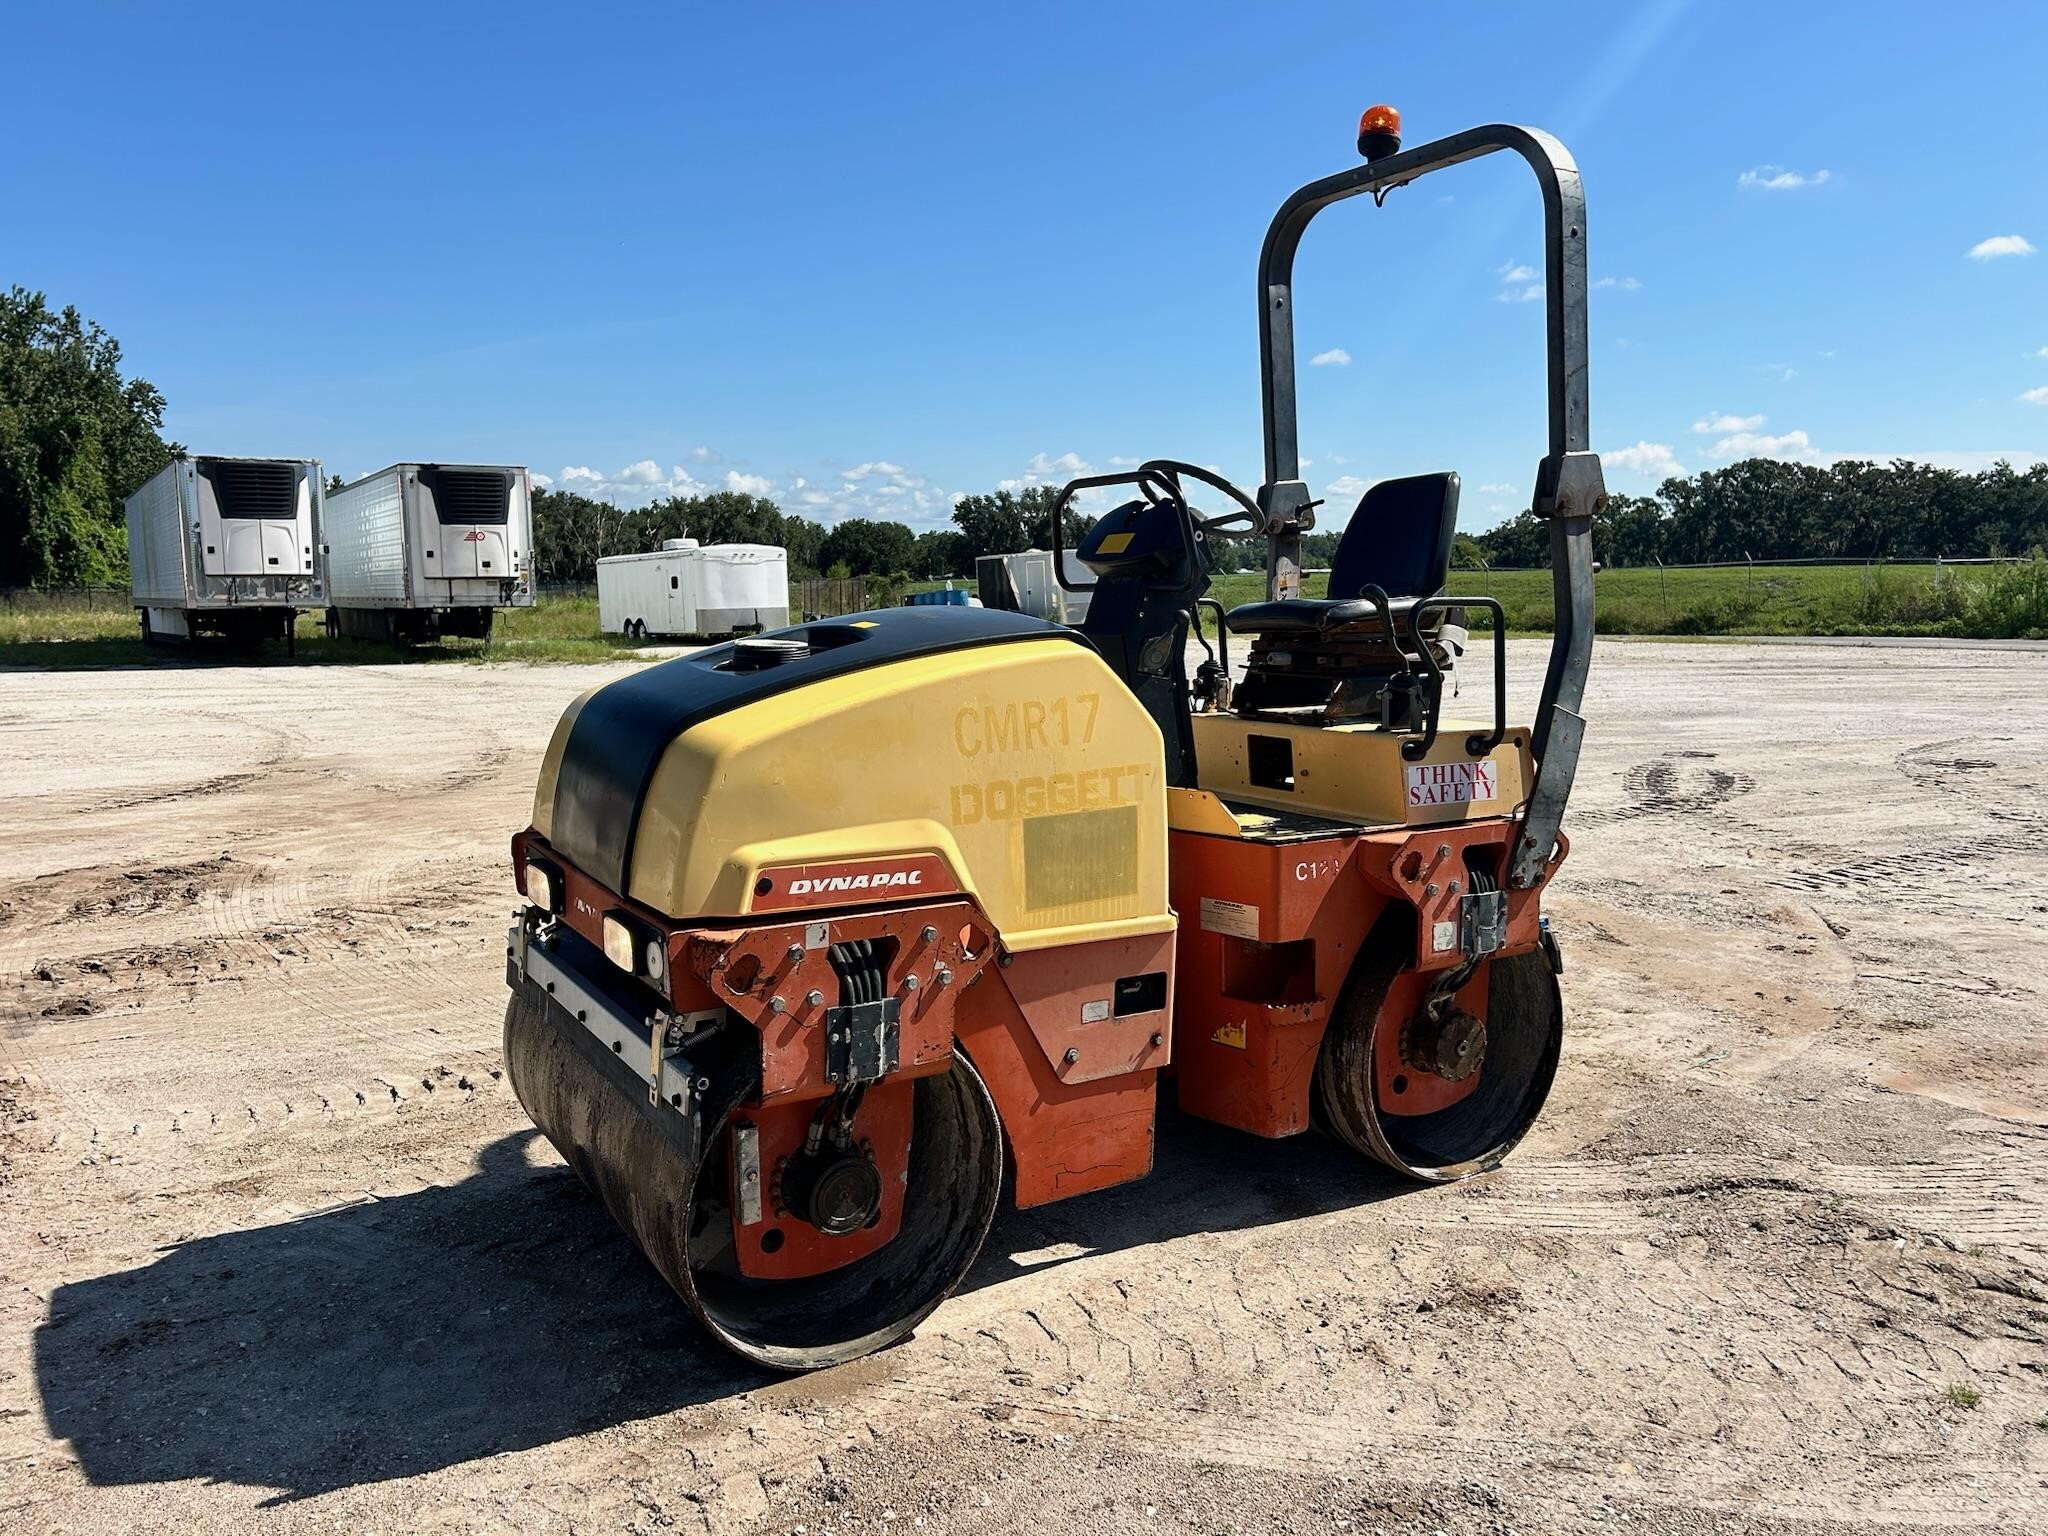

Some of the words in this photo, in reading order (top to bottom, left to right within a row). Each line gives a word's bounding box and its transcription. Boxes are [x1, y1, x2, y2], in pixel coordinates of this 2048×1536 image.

[955, 694, 1099, 757] CMR17
[1416, 762, 1488, 785] THINK
[951, 764, 1149, 826] DOGGETT
[1410, 780, 1495, 805] SAFETY
[788, 870, 921, 895] DYNAPAC
